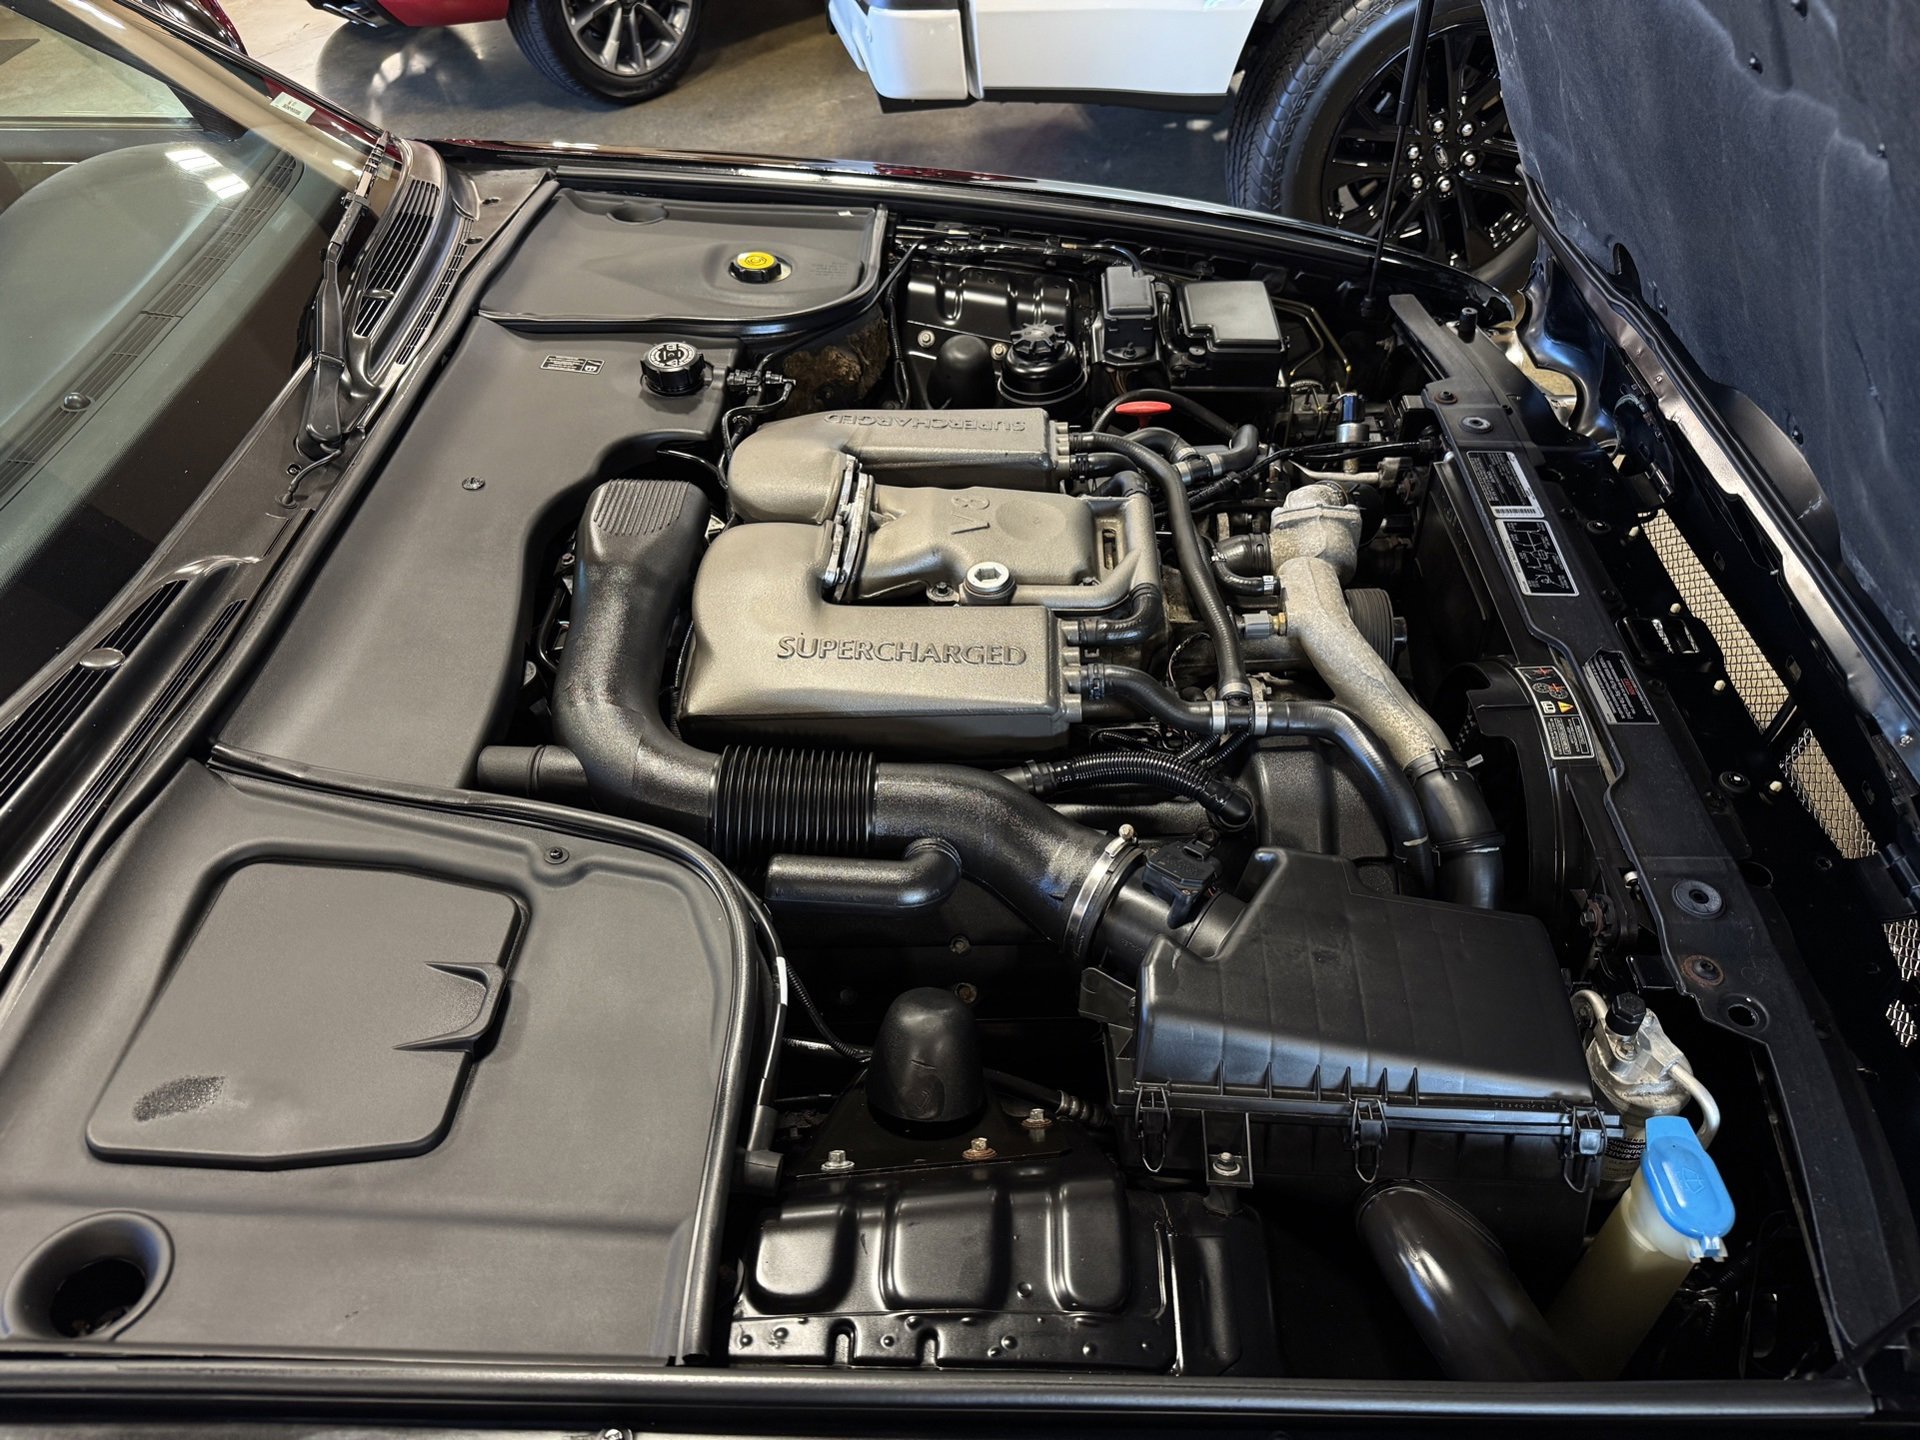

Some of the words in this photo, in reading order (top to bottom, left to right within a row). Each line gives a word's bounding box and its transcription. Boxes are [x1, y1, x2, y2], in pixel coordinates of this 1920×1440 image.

[824, 414, 1026, 431] SUPERCHARGED
[951, 496, 991, 535] V8
[777, 635, 1027, 666] SUPERCHARGED
